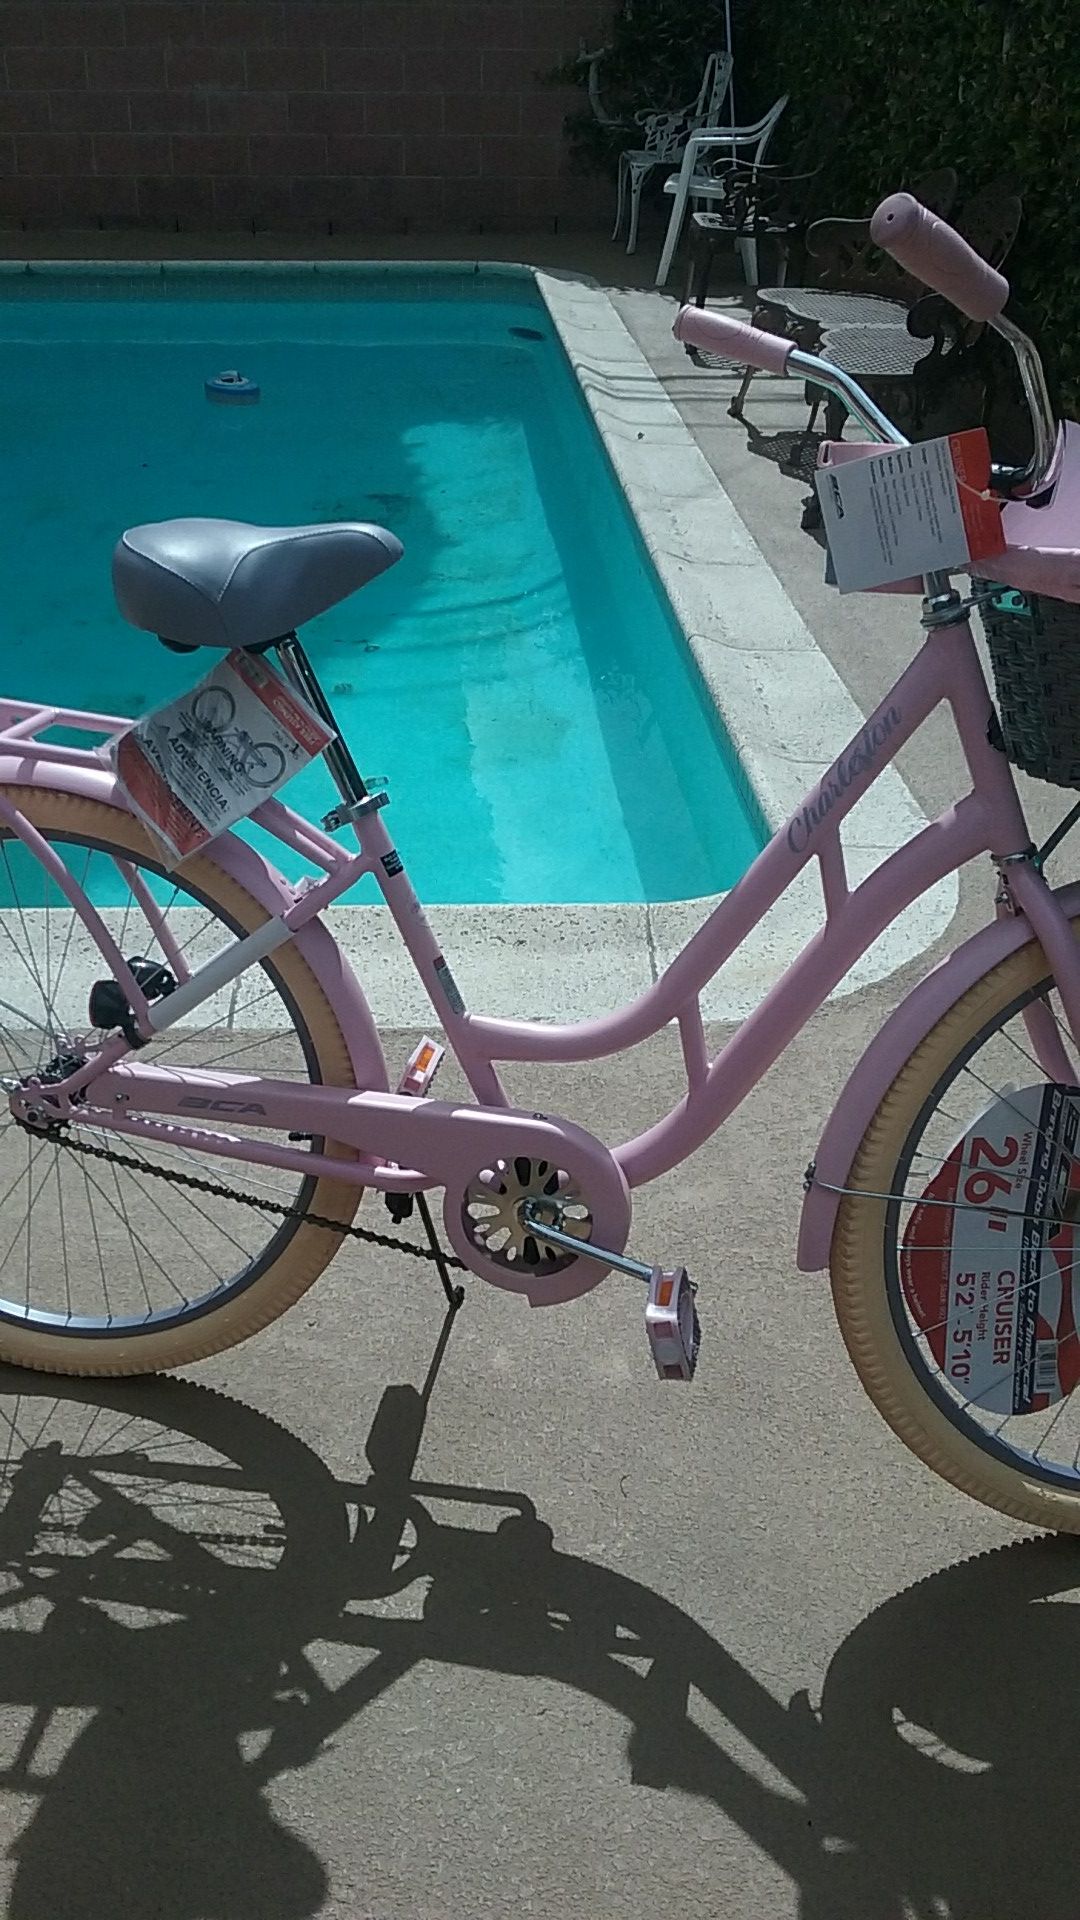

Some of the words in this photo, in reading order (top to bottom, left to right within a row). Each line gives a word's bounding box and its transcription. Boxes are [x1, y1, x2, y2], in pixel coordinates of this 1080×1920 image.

[788, 706, 901, 853] Charleston
[1019, 1132, 1033, 1165] Wheel
[1041, 1089, 1062, 1170] Bringing
[1014, 1168, 1027, 1189] Size
[1028, 1230, 1041, 1285] Back
[981, 1272, 991, 1300] Rider
[1027, 1288, 1037, 1313] to
[976, 1304, 989, 1342] Height
[993, 1270, 1015, 1365] CRUISER
